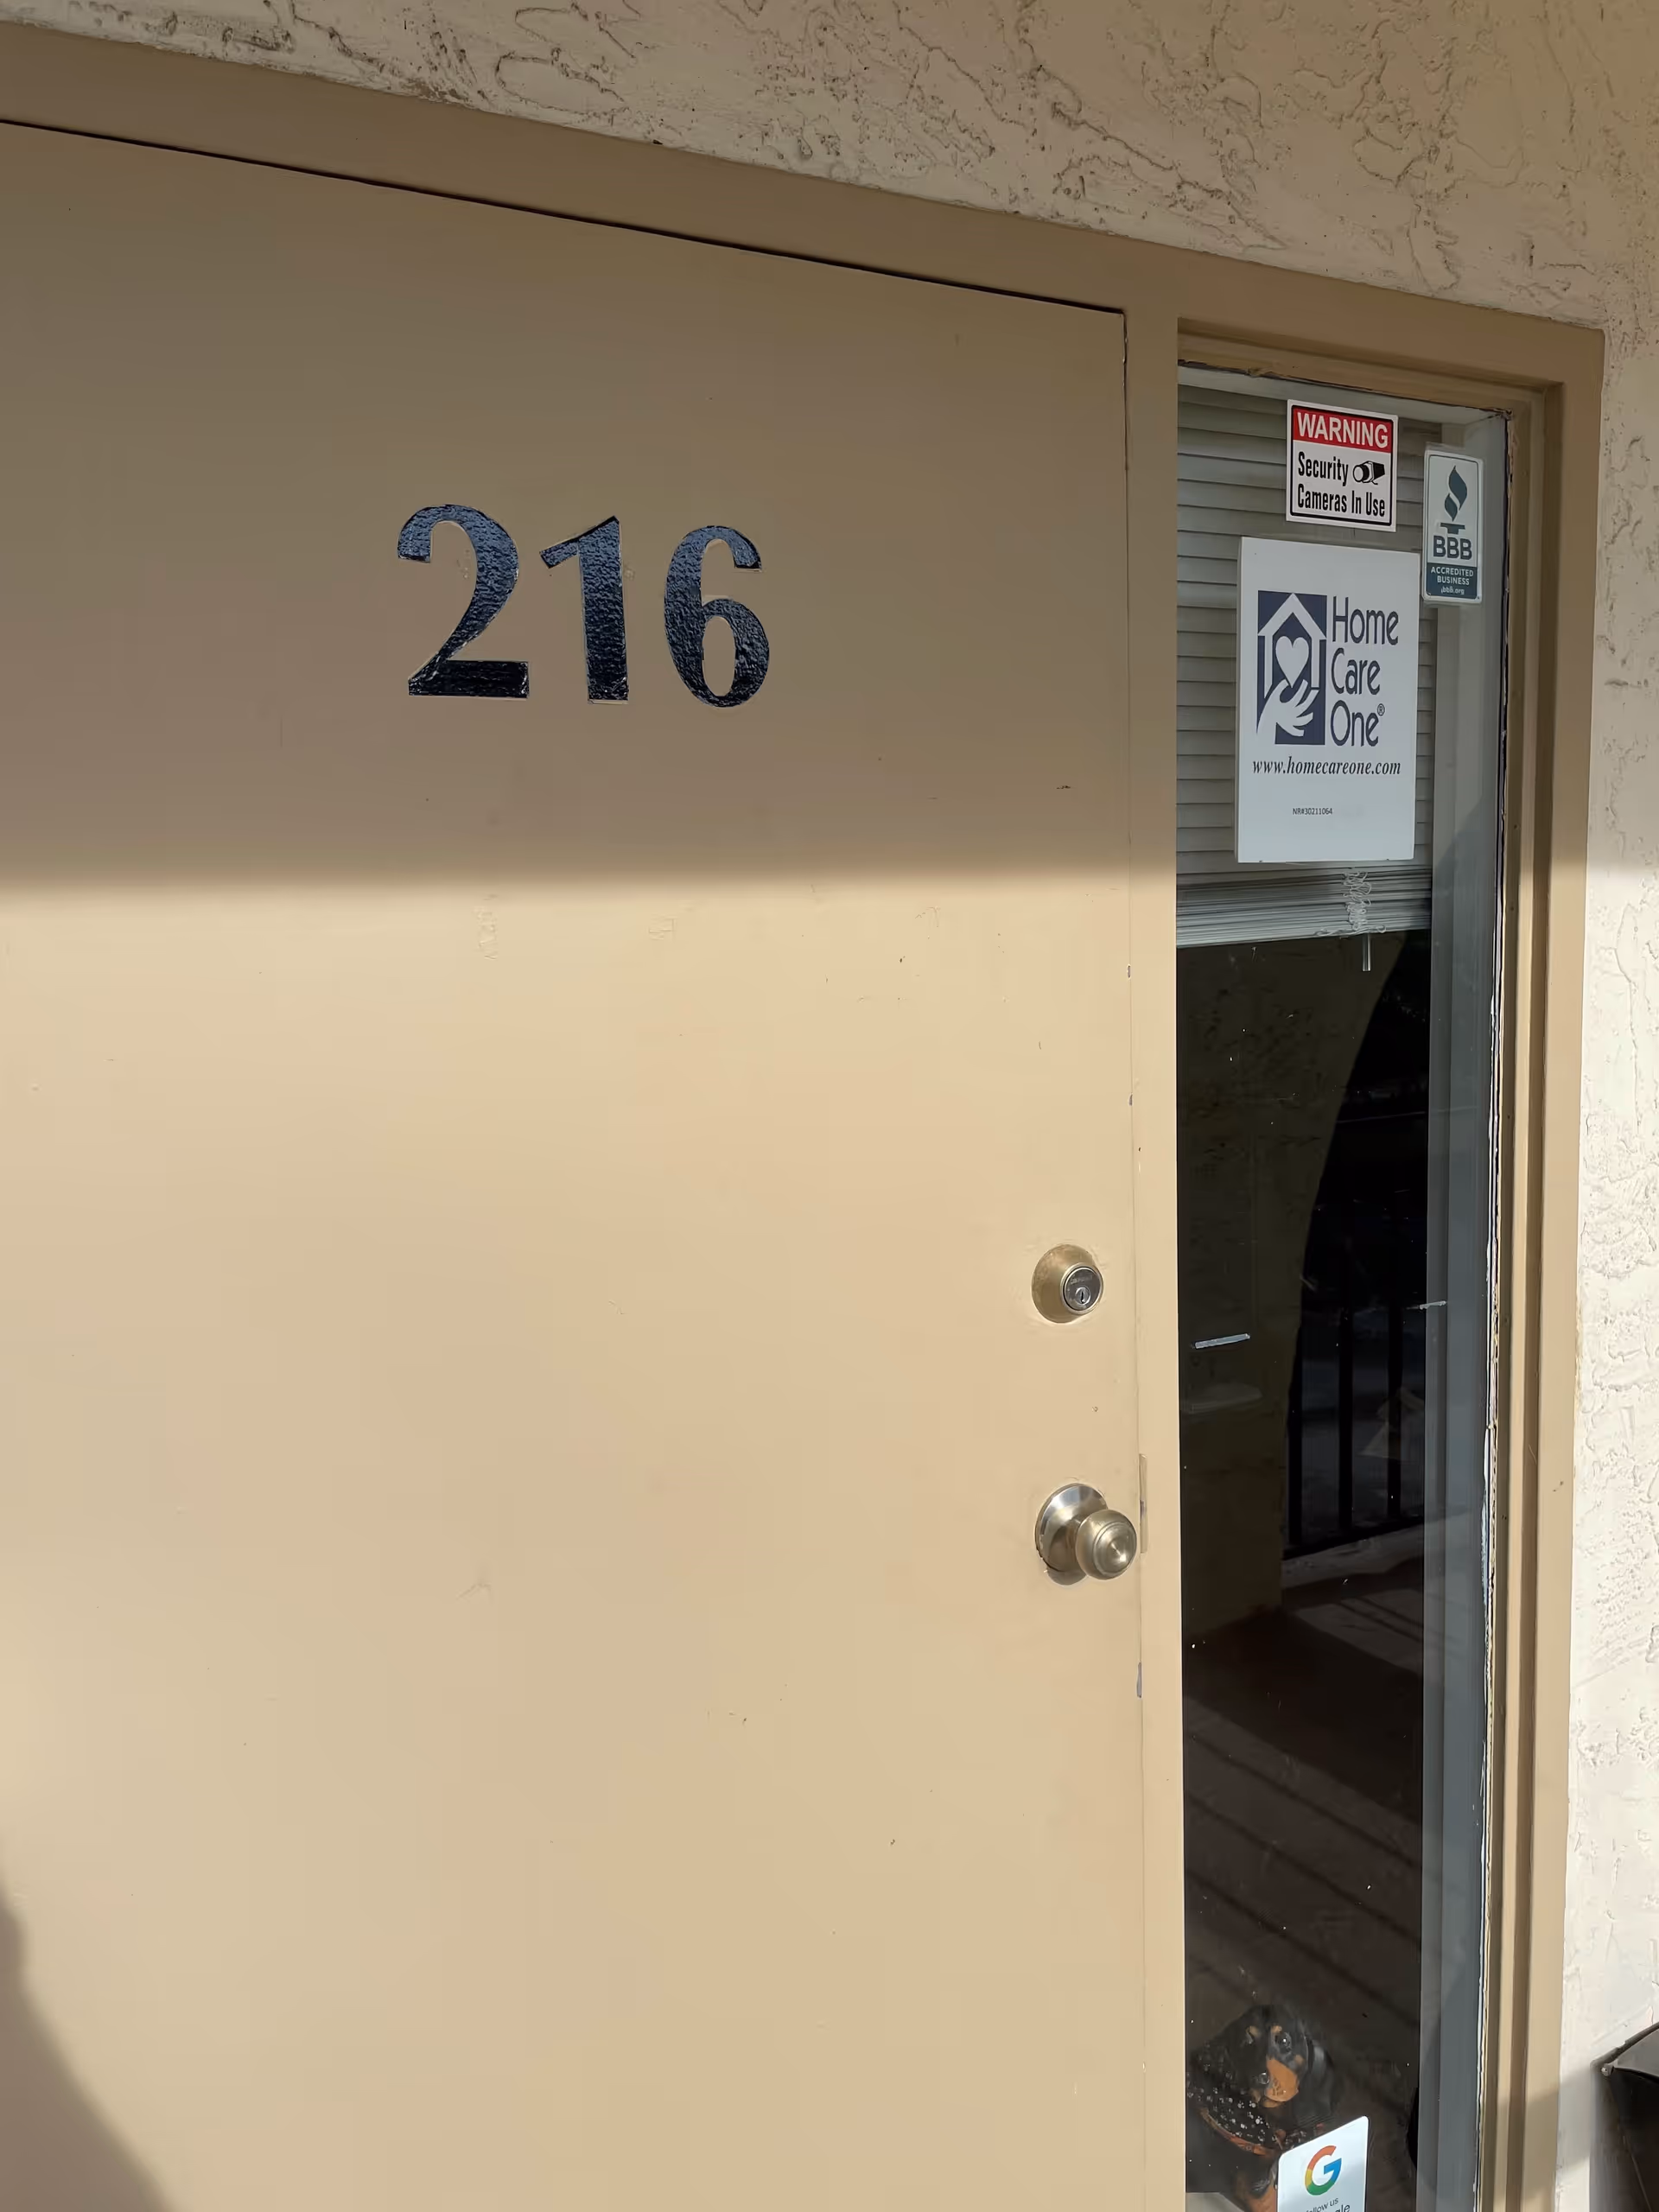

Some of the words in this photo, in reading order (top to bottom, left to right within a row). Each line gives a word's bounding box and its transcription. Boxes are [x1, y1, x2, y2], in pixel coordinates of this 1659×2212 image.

[1297, 412, 1389, 448] WARNING
[1298, 451, 1349, 486] Security
[1298, 484, 1347, 513] Cameras
[1351, 490, 1362, 514] In
[1366, 492, 1385, 517] Use
[1433, 535, 1472, 561] BBB
[1430, 566, 1474, 577] ACCREDITED
[1437, 575, 1470, 586] BUSINESS
[397, 504, 770, 709] 216
[1332, 595, 1399, 645] Home
[1332, 647, 1381, 696] Care
[1252, 755, 1402, 775] www.homecareone.com
[1329, 2197, 1339, 2207] us
